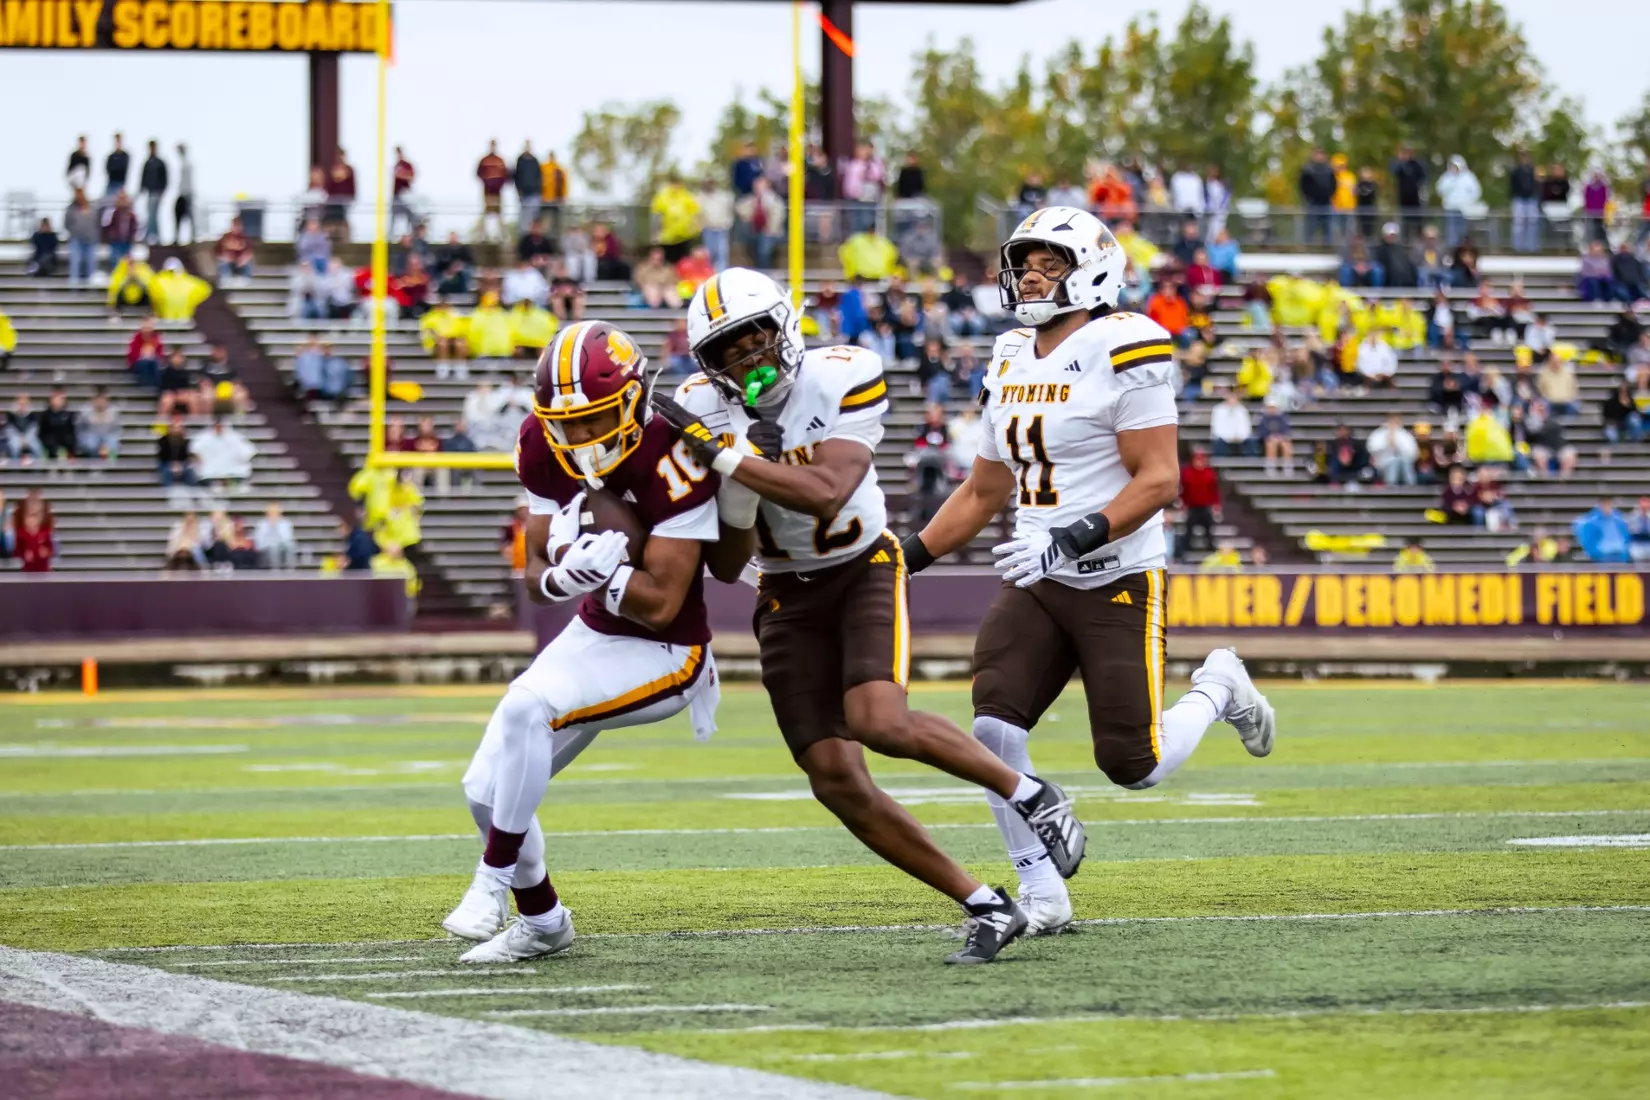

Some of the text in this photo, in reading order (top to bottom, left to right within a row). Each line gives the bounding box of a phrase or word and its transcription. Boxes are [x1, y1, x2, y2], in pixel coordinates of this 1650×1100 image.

[0, 1, 384, 51] MILY SCOREBOARD
[1000, 383, 1071, 404] WYOMING
[1006, 414, 1059, 508] 11
[1536, 573, 1645, 625] FIELD
